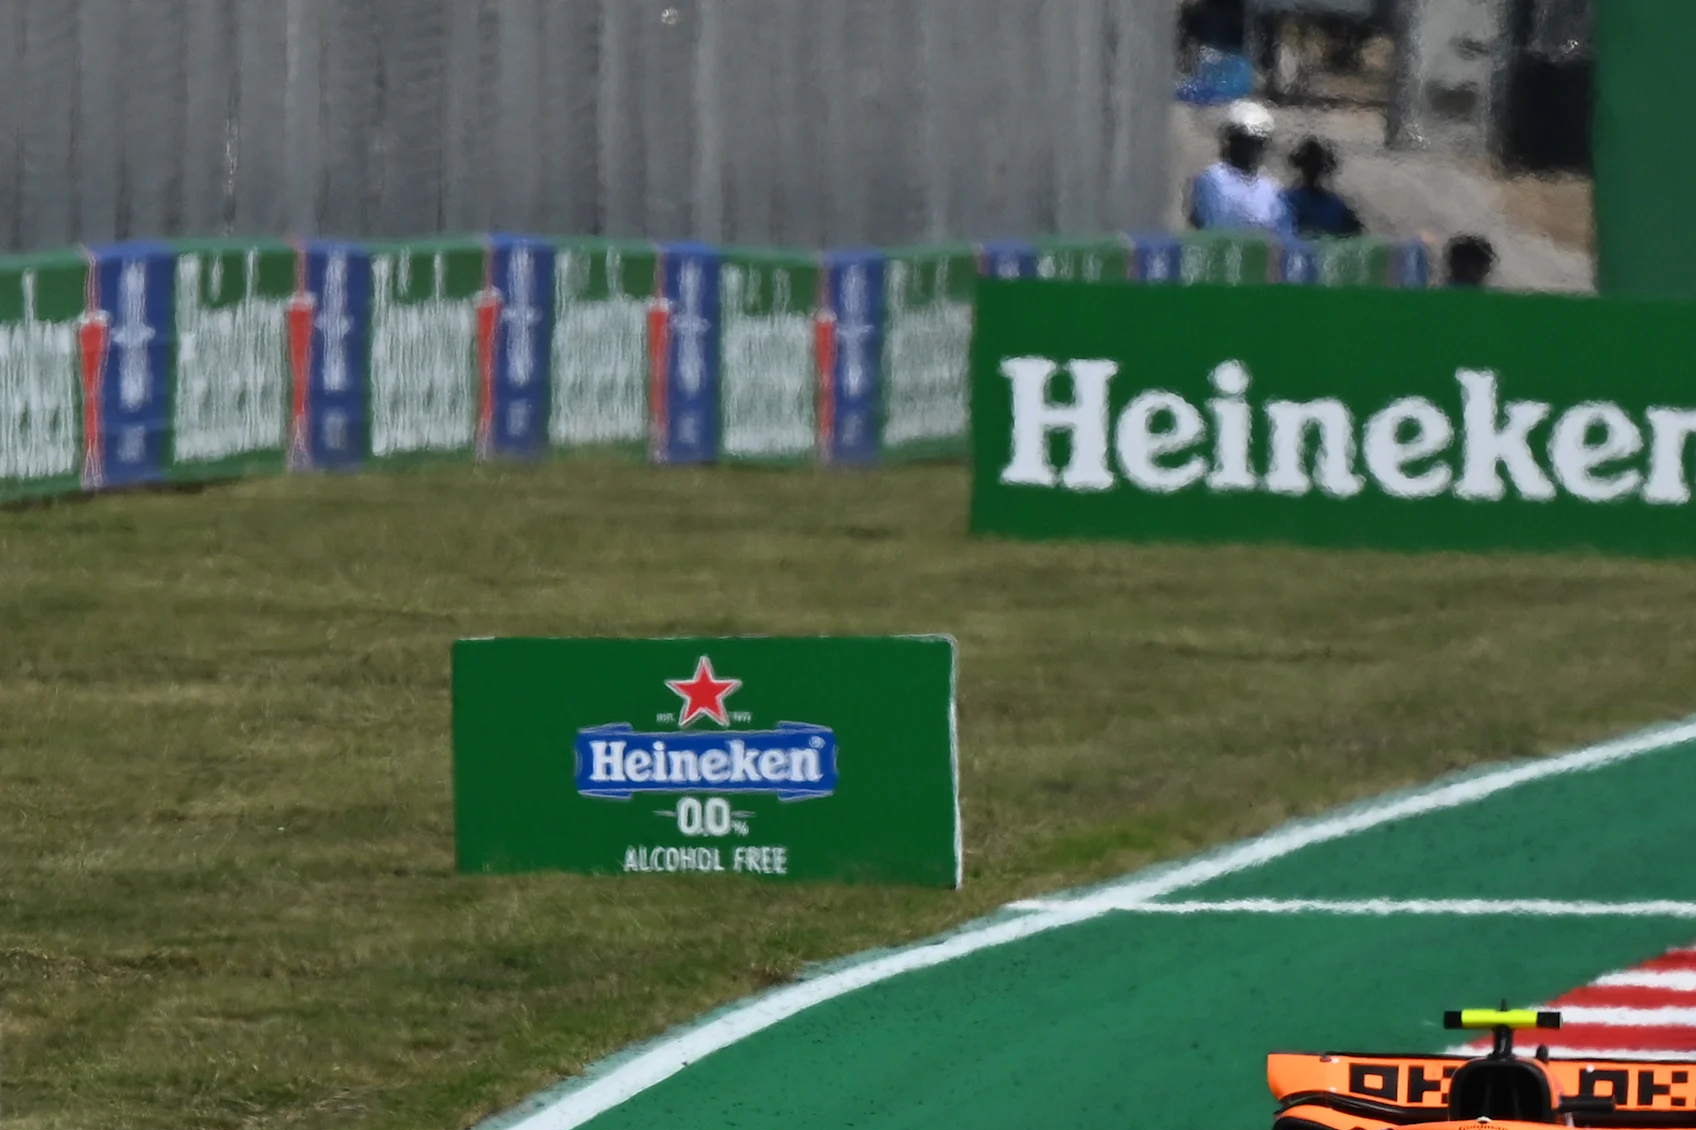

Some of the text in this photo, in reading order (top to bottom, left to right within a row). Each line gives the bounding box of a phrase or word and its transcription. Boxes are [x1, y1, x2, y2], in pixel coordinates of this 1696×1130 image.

[589, 739, 823, 783] Heineken
[624, 846, 788, 875] ALCOHOL FREE
